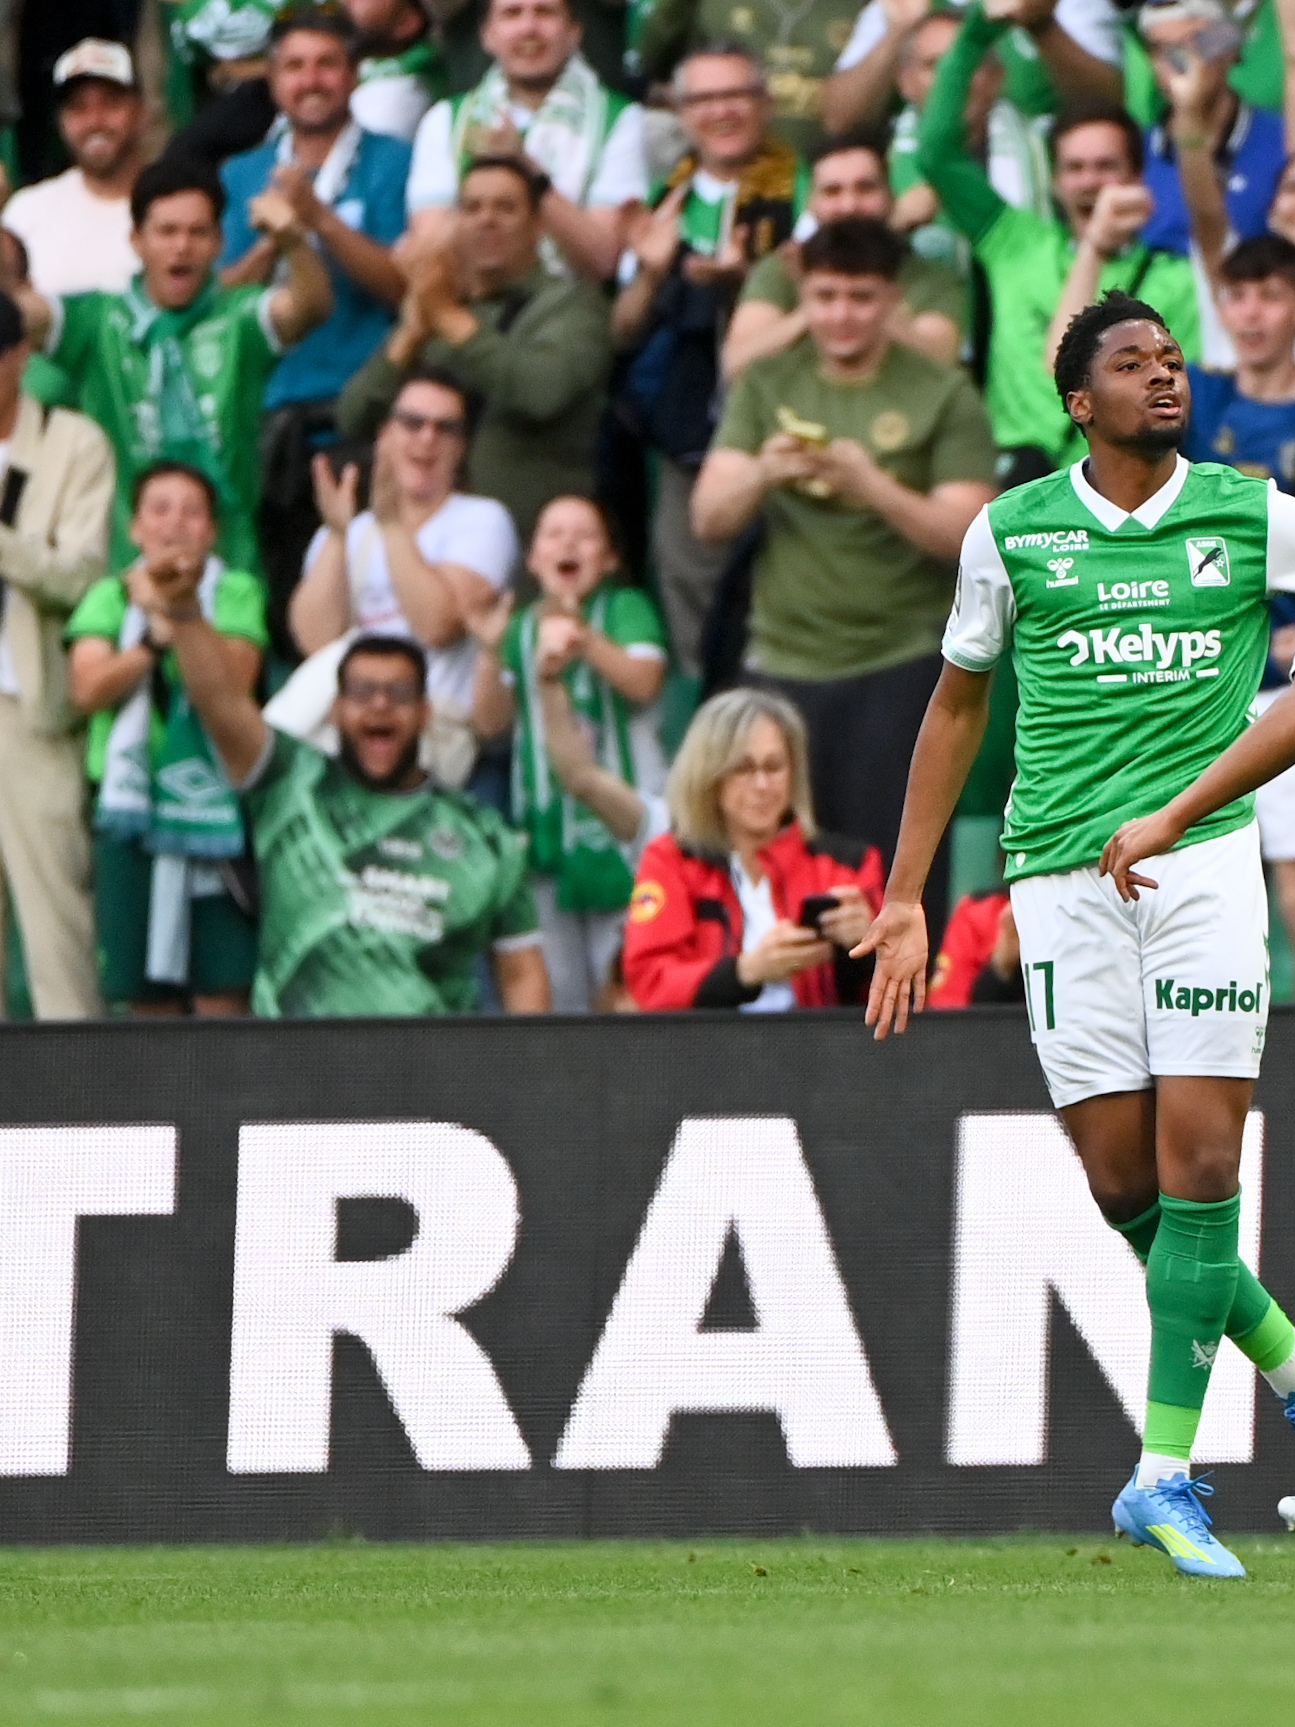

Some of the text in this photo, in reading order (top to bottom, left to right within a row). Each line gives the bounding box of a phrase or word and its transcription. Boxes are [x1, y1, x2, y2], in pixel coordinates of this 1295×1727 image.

[1052, 542, 1090, 553] LOIRE
[1097, 580, 1170, 602] Loire
[1089, 623, 1223, 670] Kelyps
[1132, 669, 1191, 684] INTERIM
